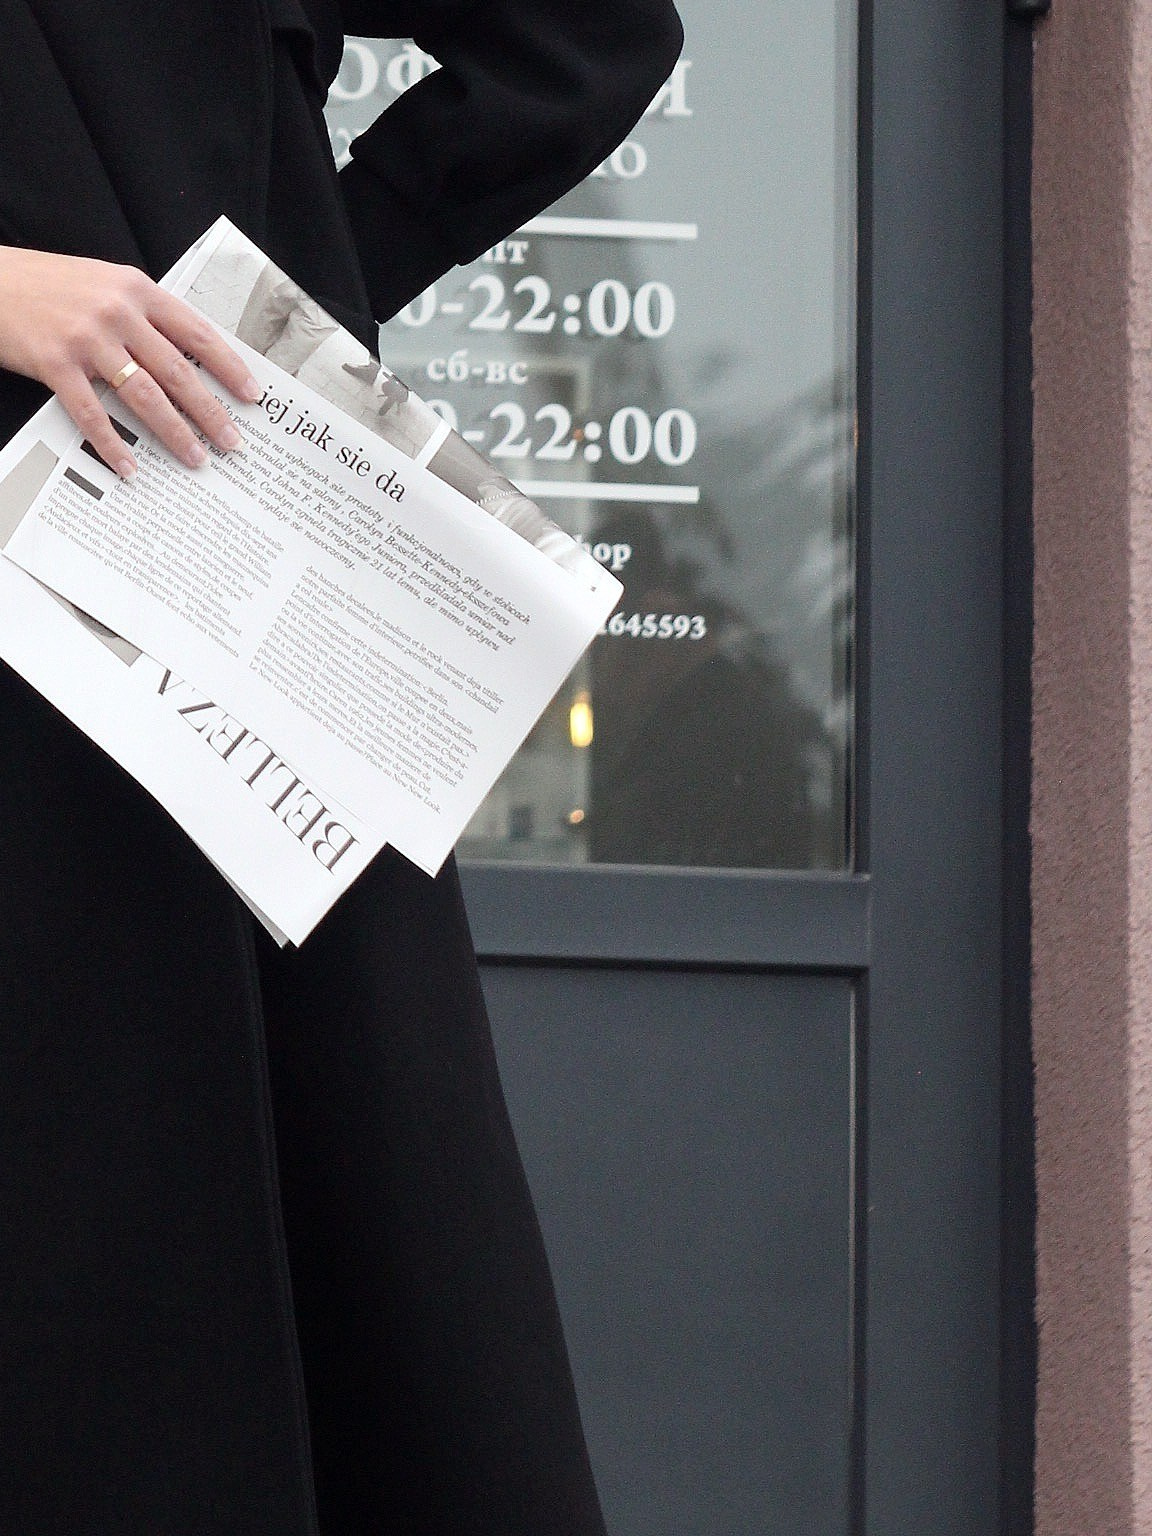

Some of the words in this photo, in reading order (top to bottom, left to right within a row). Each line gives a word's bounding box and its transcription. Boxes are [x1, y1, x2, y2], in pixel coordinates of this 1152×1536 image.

[426, 349, 529, 384] сб-вс
[272, 442, 284, 453] na
[462, 575, 482, 593] gdy
[285, 410, 335, 453] jak
[335, 446, 371, 478] sie
[375, 469, 406, 503] da
[300, 477, 312, 488] na
[347, 508, 383, 538] Carolyn
[259, 479, 294, 509] Carolyn
[369, 557, 384, 570] 21
[382, 565, 397, 579] lat
[423, 596, 438, 608] ale
[272, 472, 299, 497] Johna
[301, 493, 312, 506] F.
[496, 629, 516, 645] nad
[158, 667, 360, 875] BELLEZA
